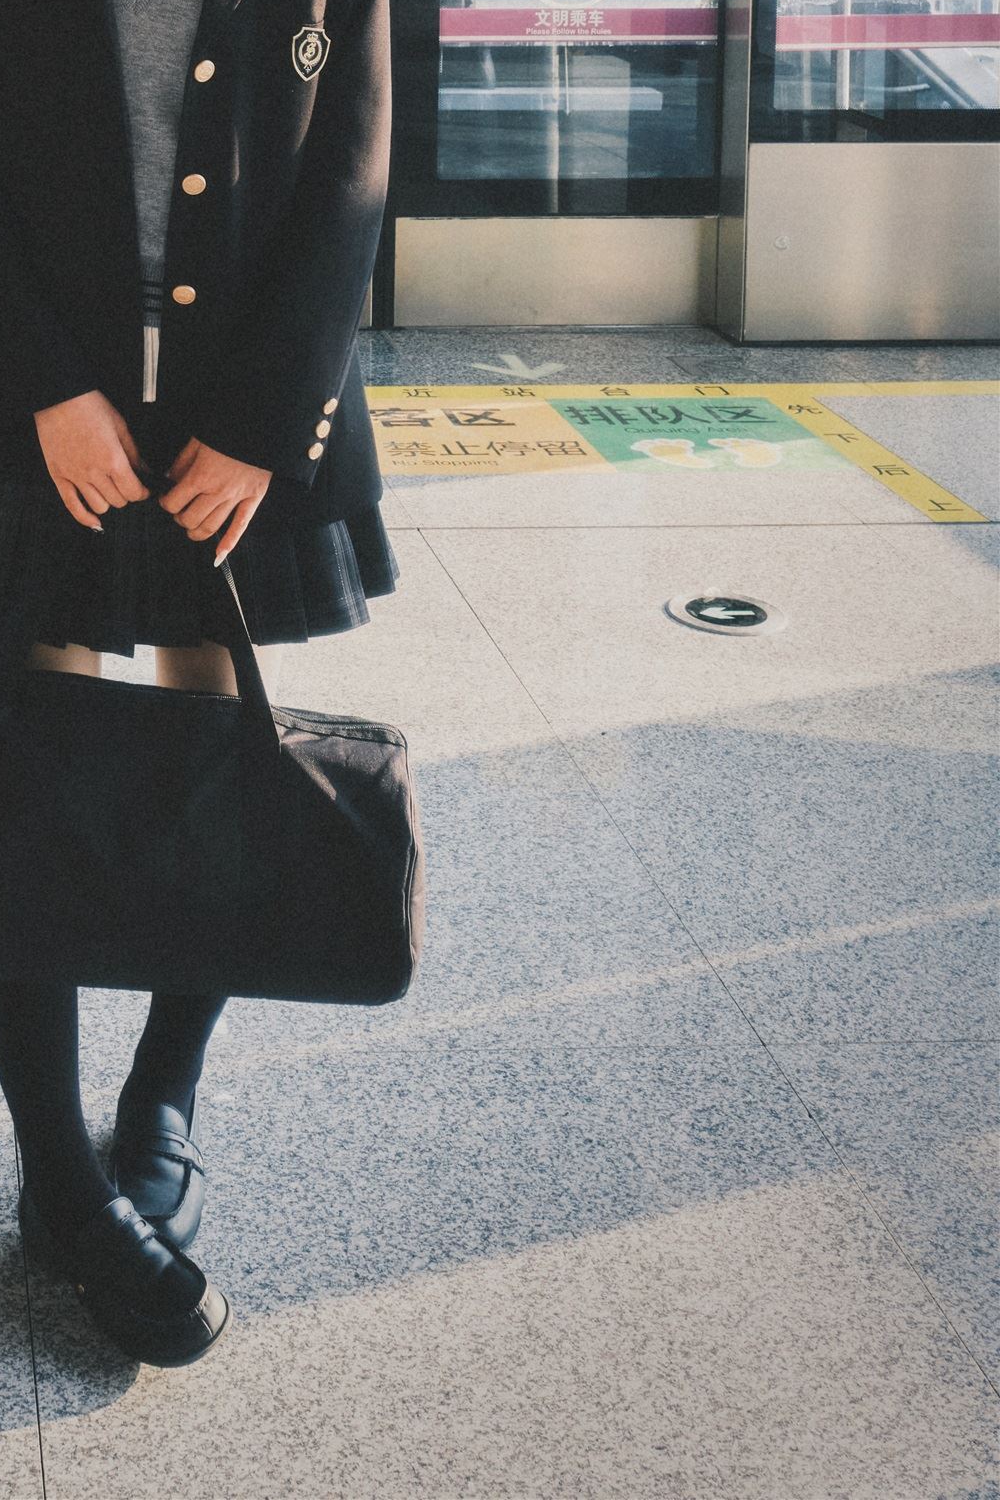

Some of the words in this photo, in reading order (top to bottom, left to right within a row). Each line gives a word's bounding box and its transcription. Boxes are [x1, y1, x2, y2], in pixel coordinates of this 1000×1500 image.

[534, 9, 605, 27] 文明乘车
[564, 405, 778, 426] 排队区
[384, 440, 588, 457] 禁止停留
[424, 459, 500, 467] Stopping
